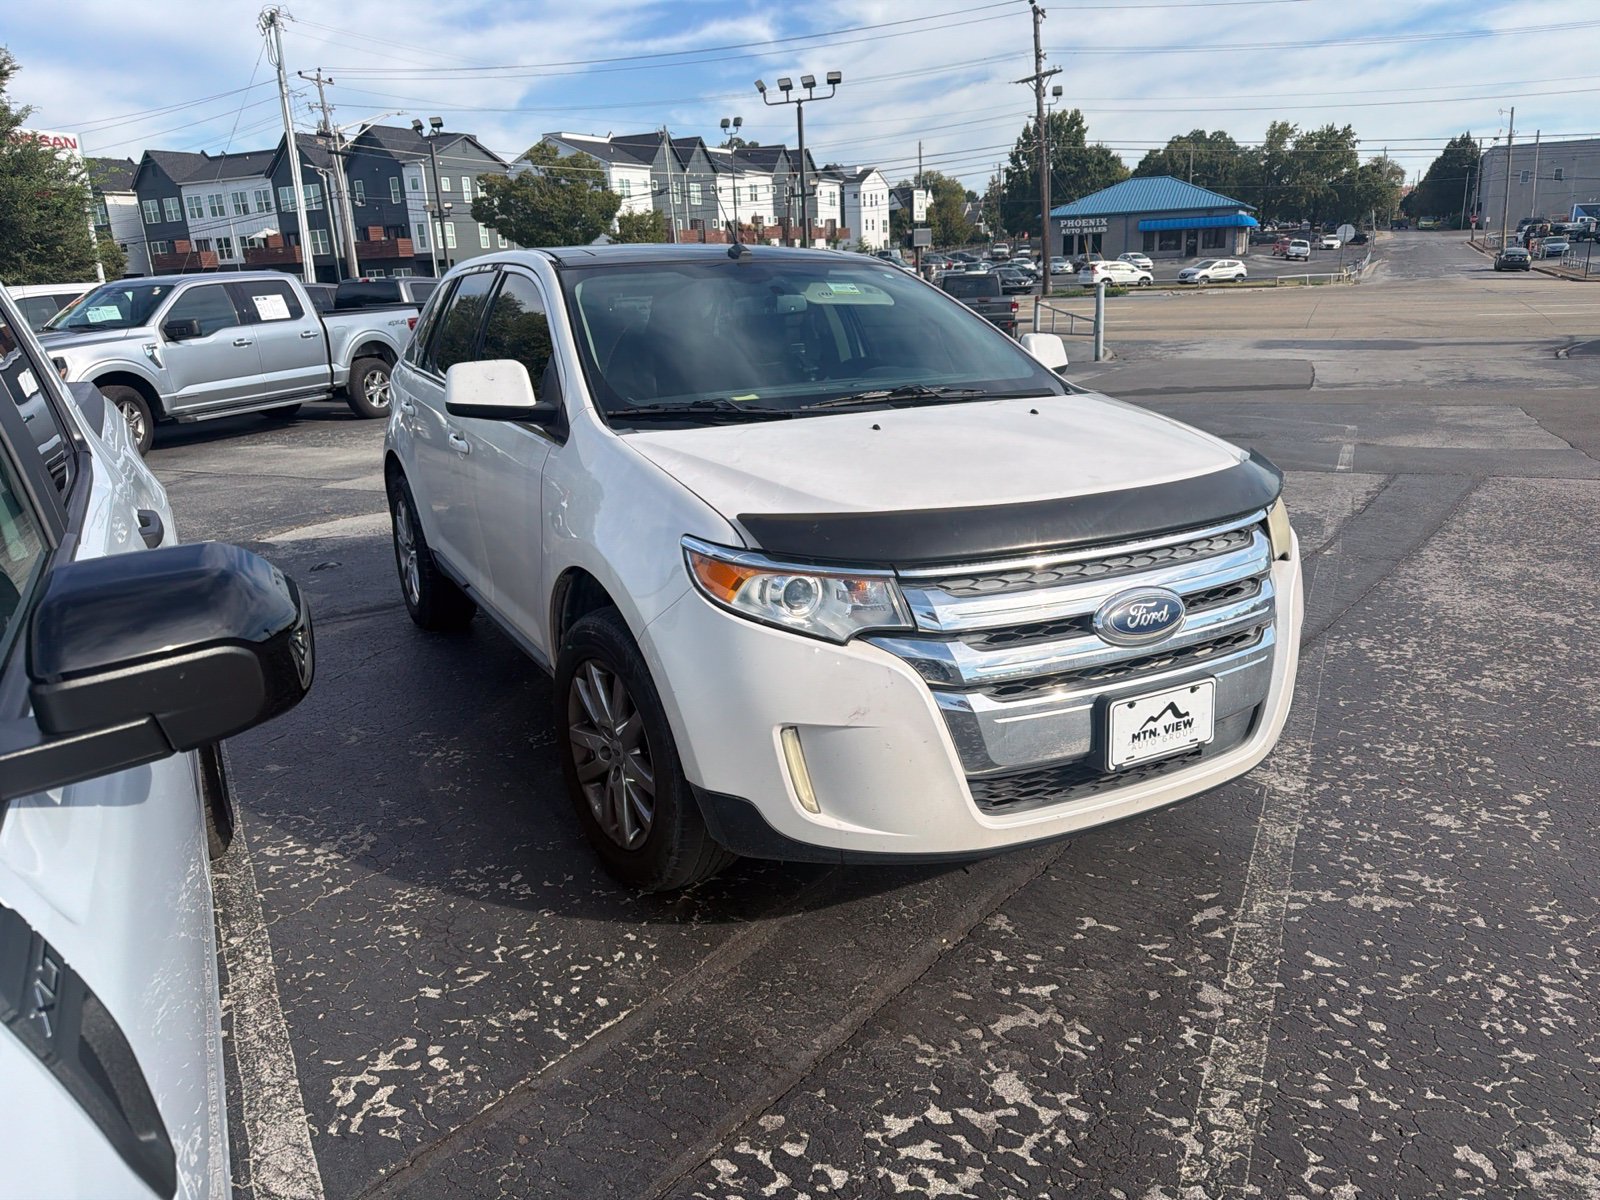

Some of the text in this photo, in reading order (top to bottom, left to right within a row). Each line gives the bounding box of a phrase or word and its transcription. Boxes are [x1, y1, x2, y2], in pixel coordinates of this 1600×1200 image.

[6, 132, 78, 150] SAN
[1060, 218, 1108, 227] PHOENIX
[1127, 601, 1169, 628] Ford
[1130, 728, 1195, 751] AUTO GROUP
[1131, 717, 1195, 743] MTN. VIEW
